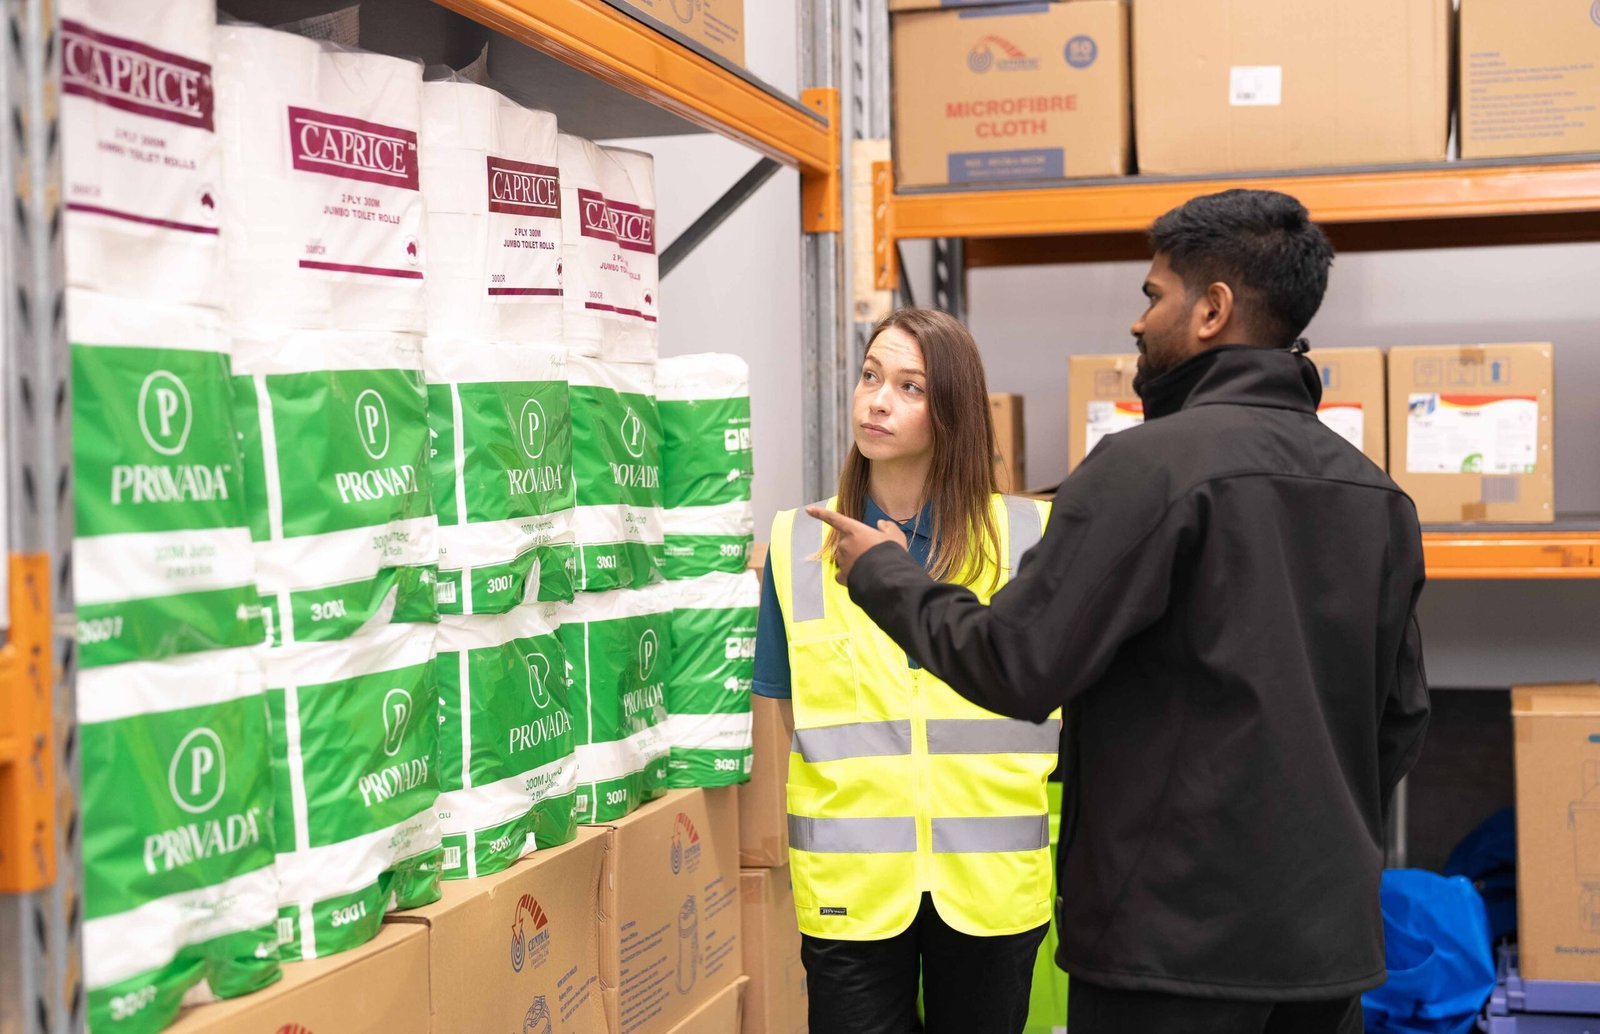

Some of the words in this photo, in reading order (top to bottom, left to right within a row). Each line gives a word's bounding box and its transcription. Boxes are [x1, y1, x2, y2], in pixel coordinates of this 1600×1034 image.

[65, 38, 202, 112] CAPRICE
[945, 94, 1077, 118] MICROFIBRE
[975, 119, 1047, 138] CLOTH
[300, 124, 406, 174] CAPRICE
[348, 194, 362, 205] PLY
[492, 171, 557, 205] CAPRICE
[323, 205, 350, 218] JUMBO
[352, 209, 376, 222] TOILET
[503, 239, 521, 249] JUMBO
[522, 240, 539, 249] TOILET
[539, 241, 555, 251] ROLLS
[519, 228, 528, 237] PLY
[155, 387, 179, 438] P
[363, 405, 380, 445] P
[528, 412, 540, 446] P
[632, 416, 641, 446] P
[507, 464, 563, 496] PROVADA
[509, 707, 572, 755] PROVADA
[190, 745, 214, 796] P
[526, 773, 545, 791] 300M
